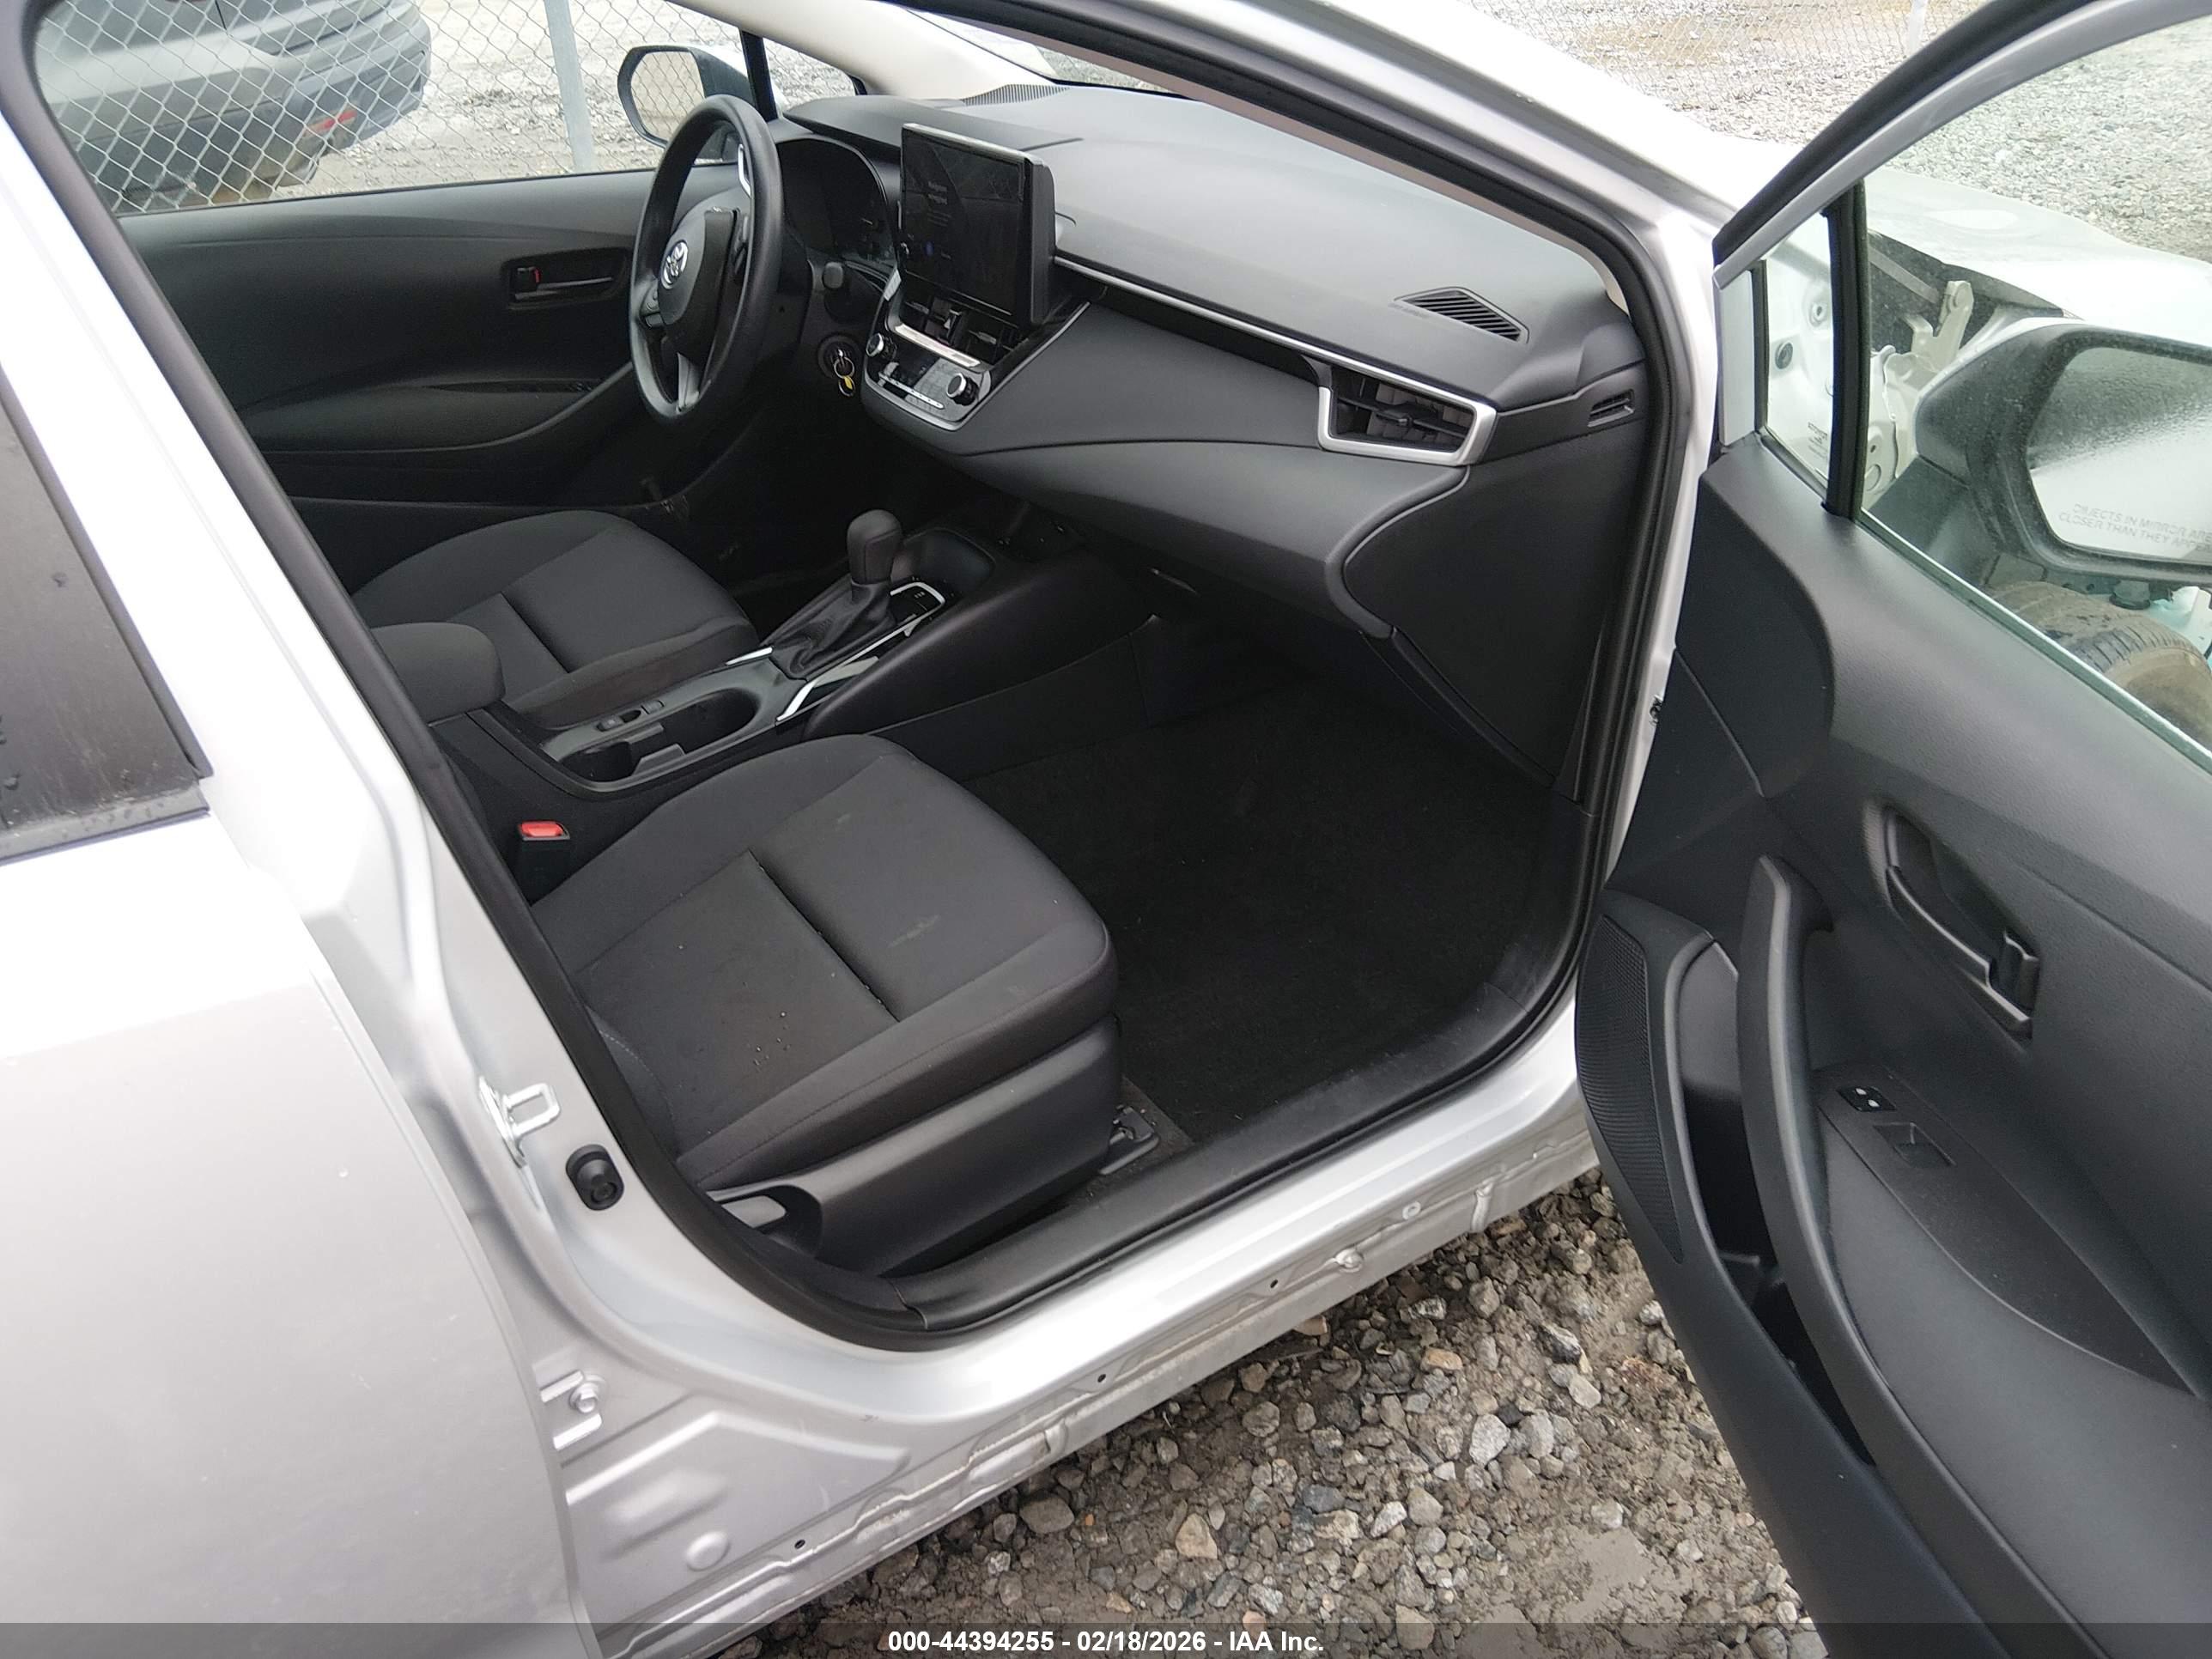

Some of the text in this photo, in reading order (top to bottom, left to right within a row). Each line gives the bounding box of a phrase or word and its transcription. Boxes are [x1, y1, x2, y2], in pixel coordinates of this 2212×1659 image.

[2059, 512, 2103, 530] CLOSER
[2107, 521, 2136, 538] THAN
[2141, 529, 2171, 544] THEY
[2073, 502, 2124, 523] OBJECTS
[2124, 515, 2137, 526] IN
[2139, 517, 2186, 536] MIRROR
